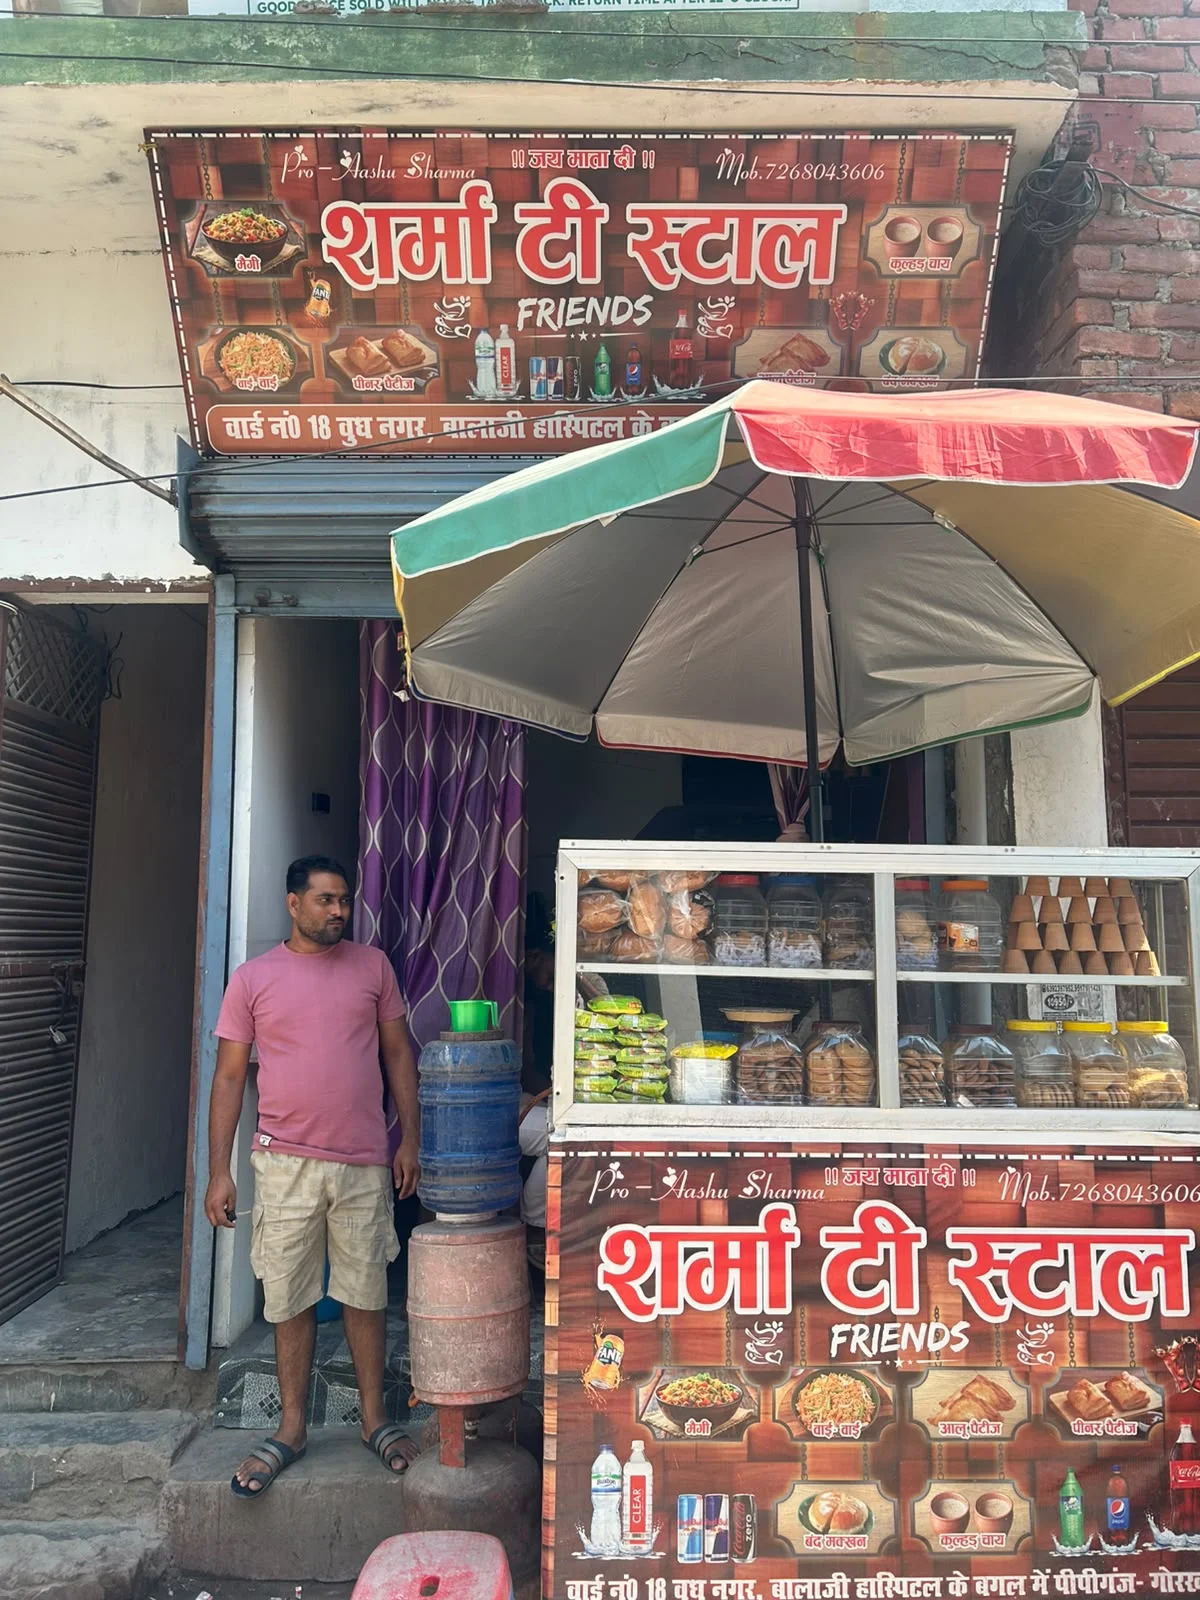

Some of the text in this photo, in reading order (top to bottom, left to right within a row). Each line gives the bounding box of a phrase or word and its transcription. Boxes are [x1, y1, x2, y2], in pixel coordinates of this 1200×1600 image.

[257, 2, 294, 13] GOOD
[281, 147, 313, 184] Pro
[403, 151, 477, 180] Sharma
[528, 149, 565, 168] जय
[567, 149, 611, 169] माता
[614, 144, 636, 170] दी
[321, 177, 848, 291] शर्मा टी स्टाल
[235, 254, 262, 272] मैगी
[928, 256, 952, 271] चाय
[517, 294, 654, 332] FRIENDS
[307, 415, 331, 439] 18
[440, 410, 527, 439] बालाजी
[589, 1162, 629, 1203] Pro
[738, 1170, 825, 1200] Sharma
[842, 1167, 880, 1186] जय
[883, 1168, 929, 1187] माता
[932, 1163, 956, 1188] दी
[598, 1200, 1196, 1323] शर्मा टी स्टाल
[830, 1321, 970, 1358] FRIENDS
[685, 1418, 712, 1436] मैगी
[938, 1418, 1003, 1440] आलू पैटीज
[1105, 1418, 1138, 1436] पैटीज
[632, 1488, 642, 1524] CLEAR
[824, 1534, 868, 1550] मक्खन
[980, 1533, 1006, 1547] चाय
[645, 1578, 666, 1600] 18
[770, 1572, 851, 1600] बालाजी
[946, 1571, 970, 1597] के
[973, 1576, 1027, 1597] बगल
[1030, 1568, 1051, 1595] में
